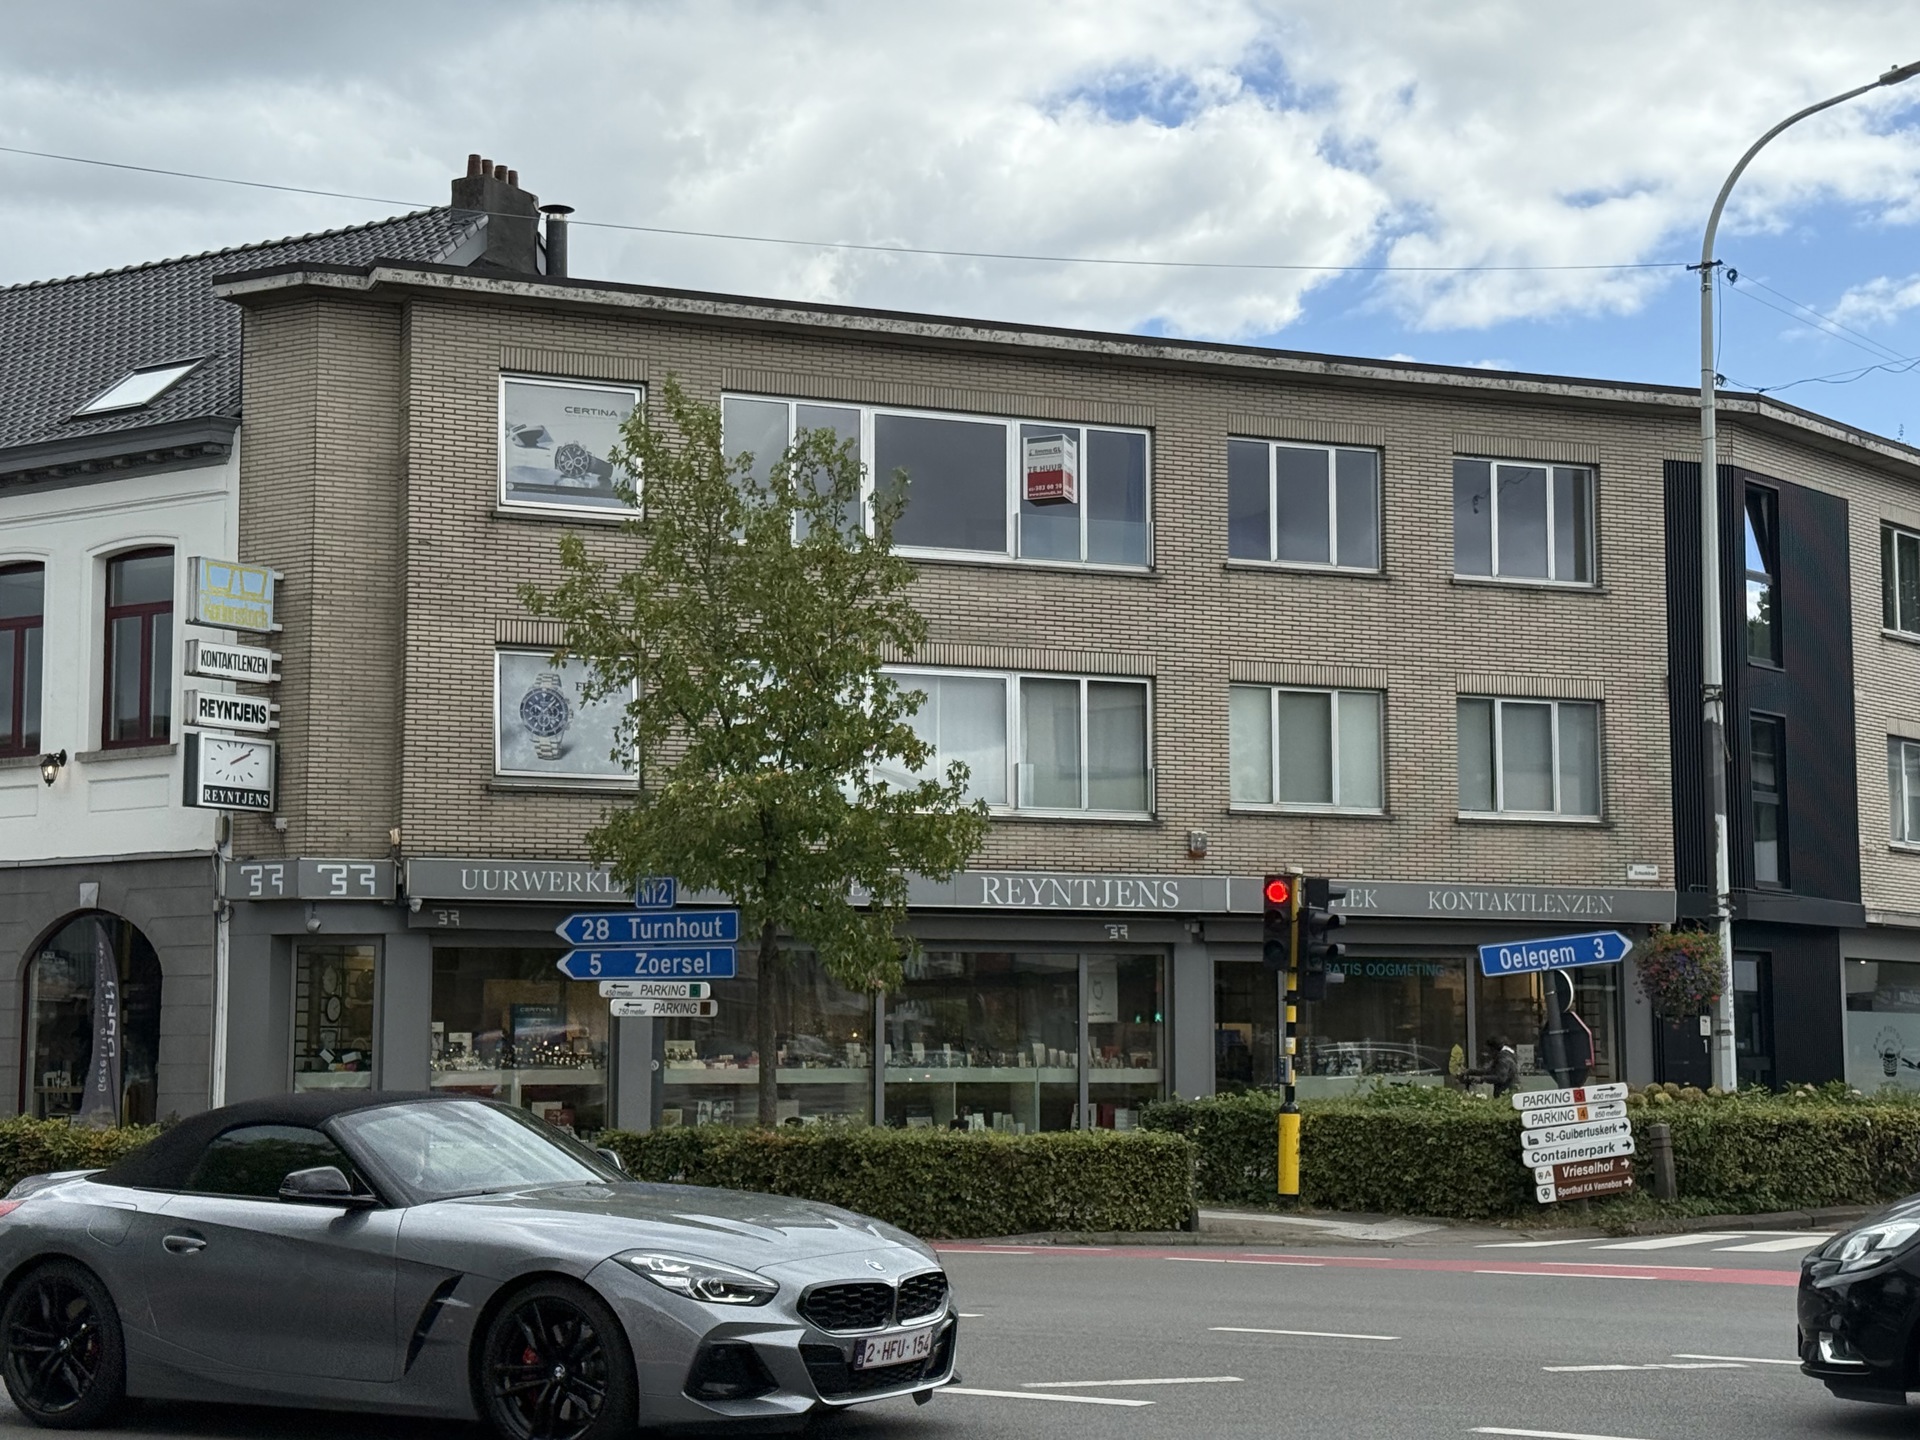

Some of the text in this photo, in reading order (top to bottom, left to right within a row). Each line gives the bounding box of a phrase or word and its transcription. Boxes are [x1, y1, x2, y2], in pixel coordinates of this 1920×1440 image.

[565, 406, 618, 417] CERTINA
[1027, 463, 1062, 473] TE HUUR
[201, 649, 268, 675] KONTAKTLENZEN
[199, 698, 267, 725] REYNTJENS
[204, 788, 269, 806] REYNTJENS
[641, 882, 668, 904] N12
[980, 876, 1180, 909] REYNTJENS
[1427, 890, 1614, 914] KONTAKTLENZEN
[582, 916, 723, 941] 28 Turnhout
[590, 951, 711, 976] 5 Zoersel
[1499, 938, 1606, 970] Oelegem 3
[1365, 962, 1445, 977] OOGMETING
[640, 984, 686, 996] PARKING
[653, 1002, 697, 1014] PARKING
[1522, 1091, 1571, 1108] PARKING
[1531, 1109, 1575, 1126] PARKING
[1580, 1109, 1586, 1118] 4
[1545, 1123, 1618, 1143] St.-Guibertuskerk
[1531, 1142, 1616, 1163] Containerpark
[1562, 1158, 1614, 1178] Vrieselhof
[1557, 1184, 1584, 1197] Sporthal
[1584, 1182, 1593, 1192] KA
